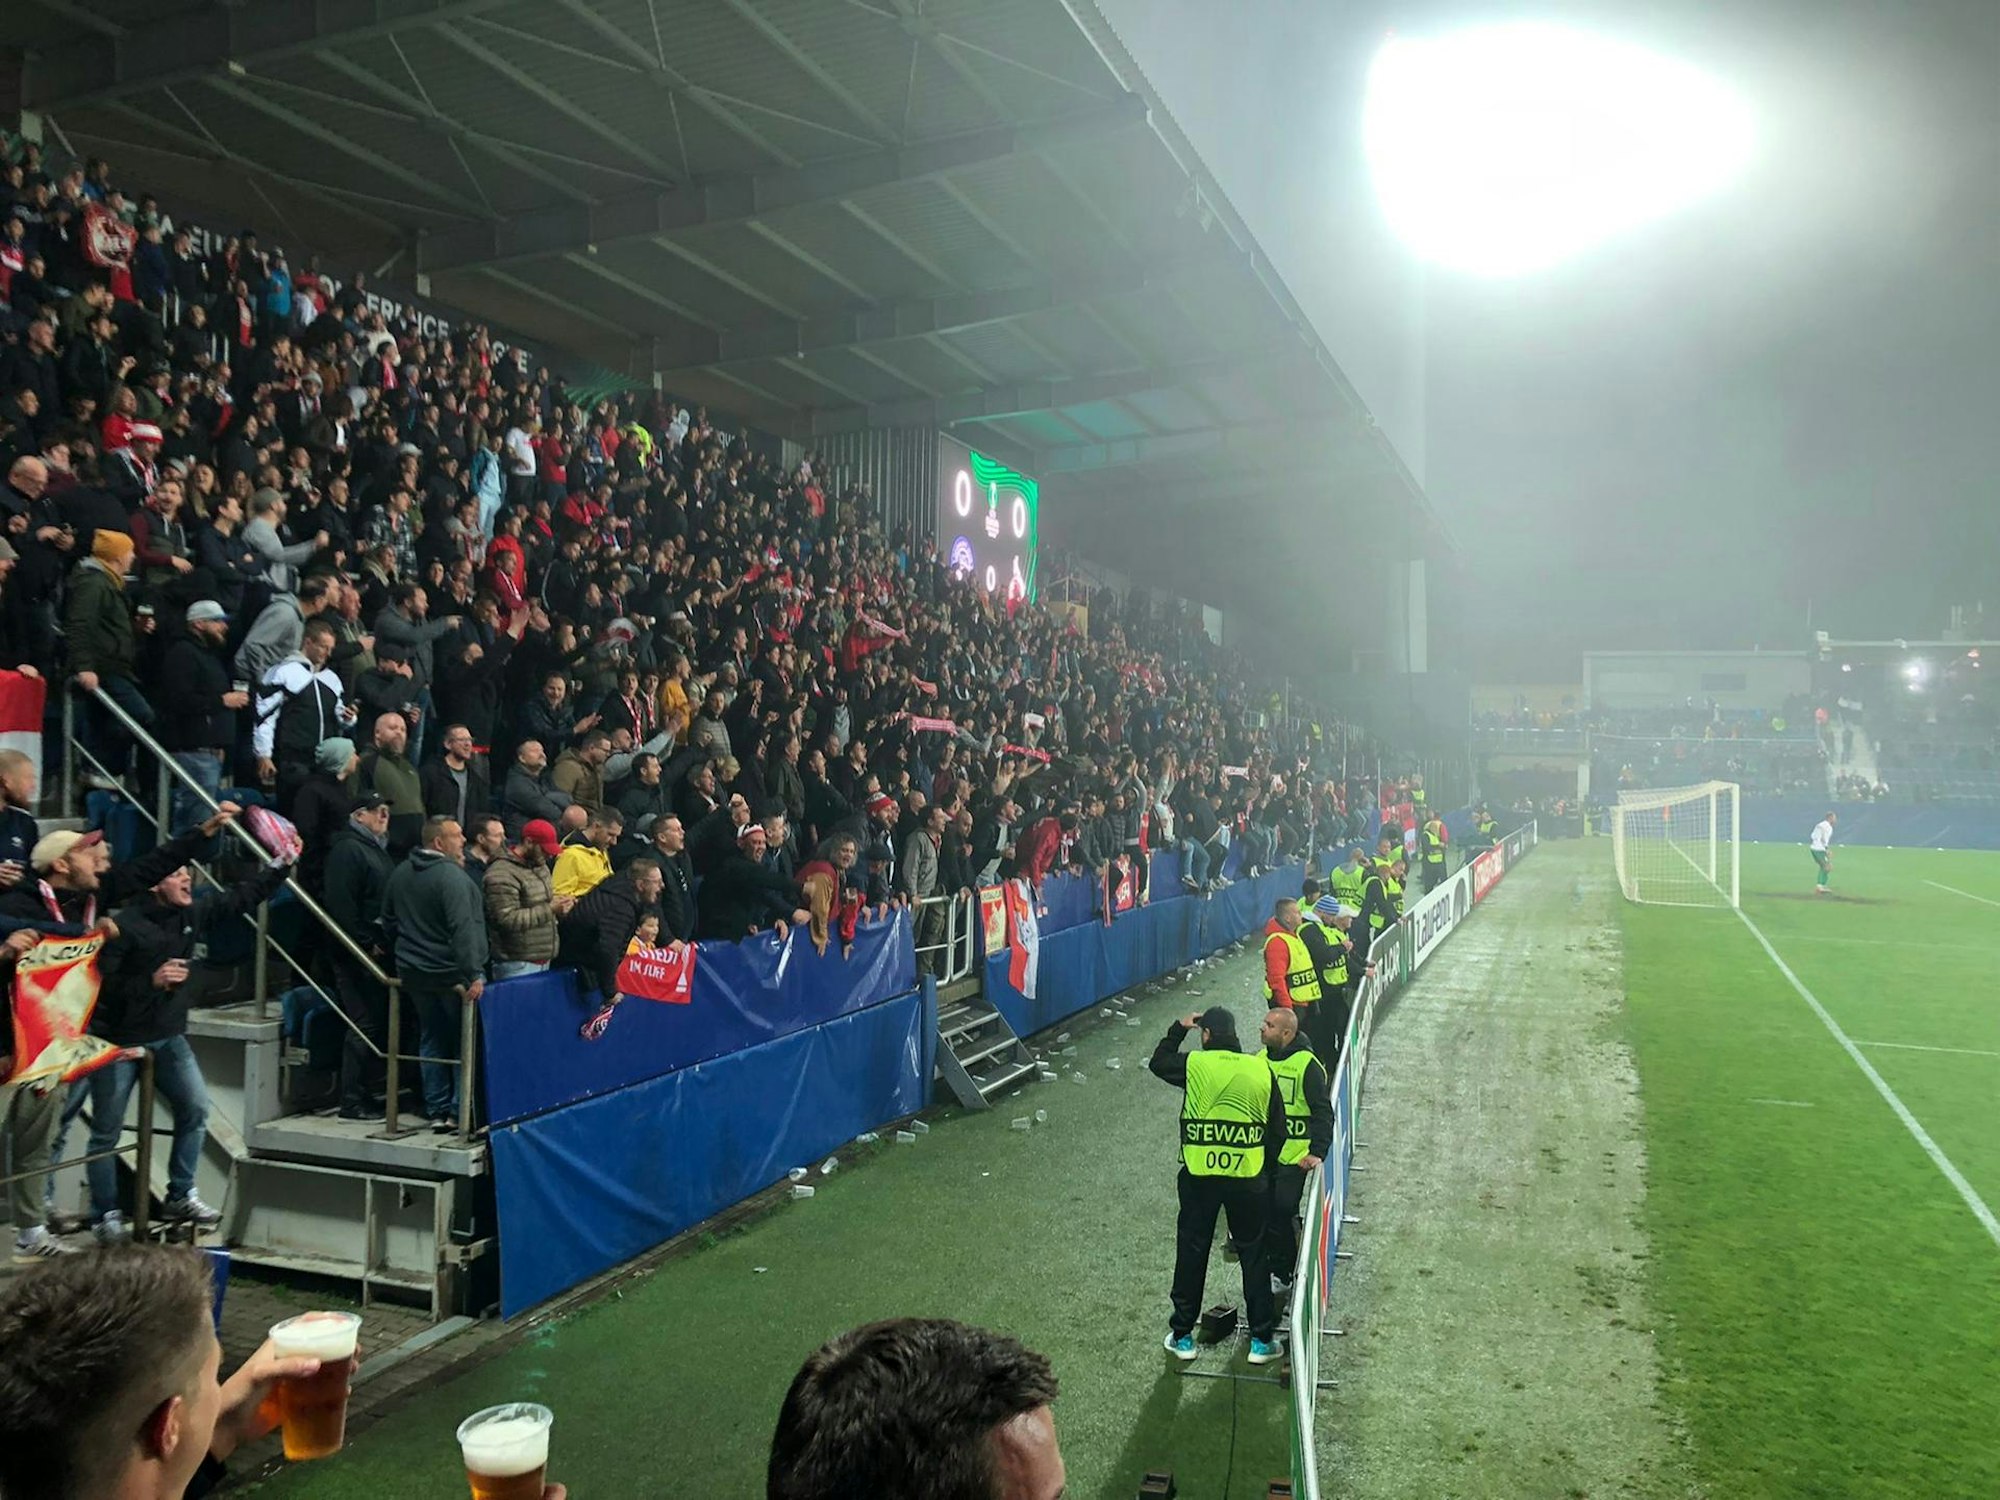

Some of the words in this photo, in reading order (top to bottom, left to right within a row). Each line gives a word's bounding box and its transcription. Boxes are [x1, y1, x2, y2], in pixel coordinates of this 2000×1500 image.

[955, 469, 972, 518] 0
[1012, 497, 1026, 539] 0
[1186, 1123, 1265, 1144] STEWARD
[1206, 1151, 1244, 1170] 007
